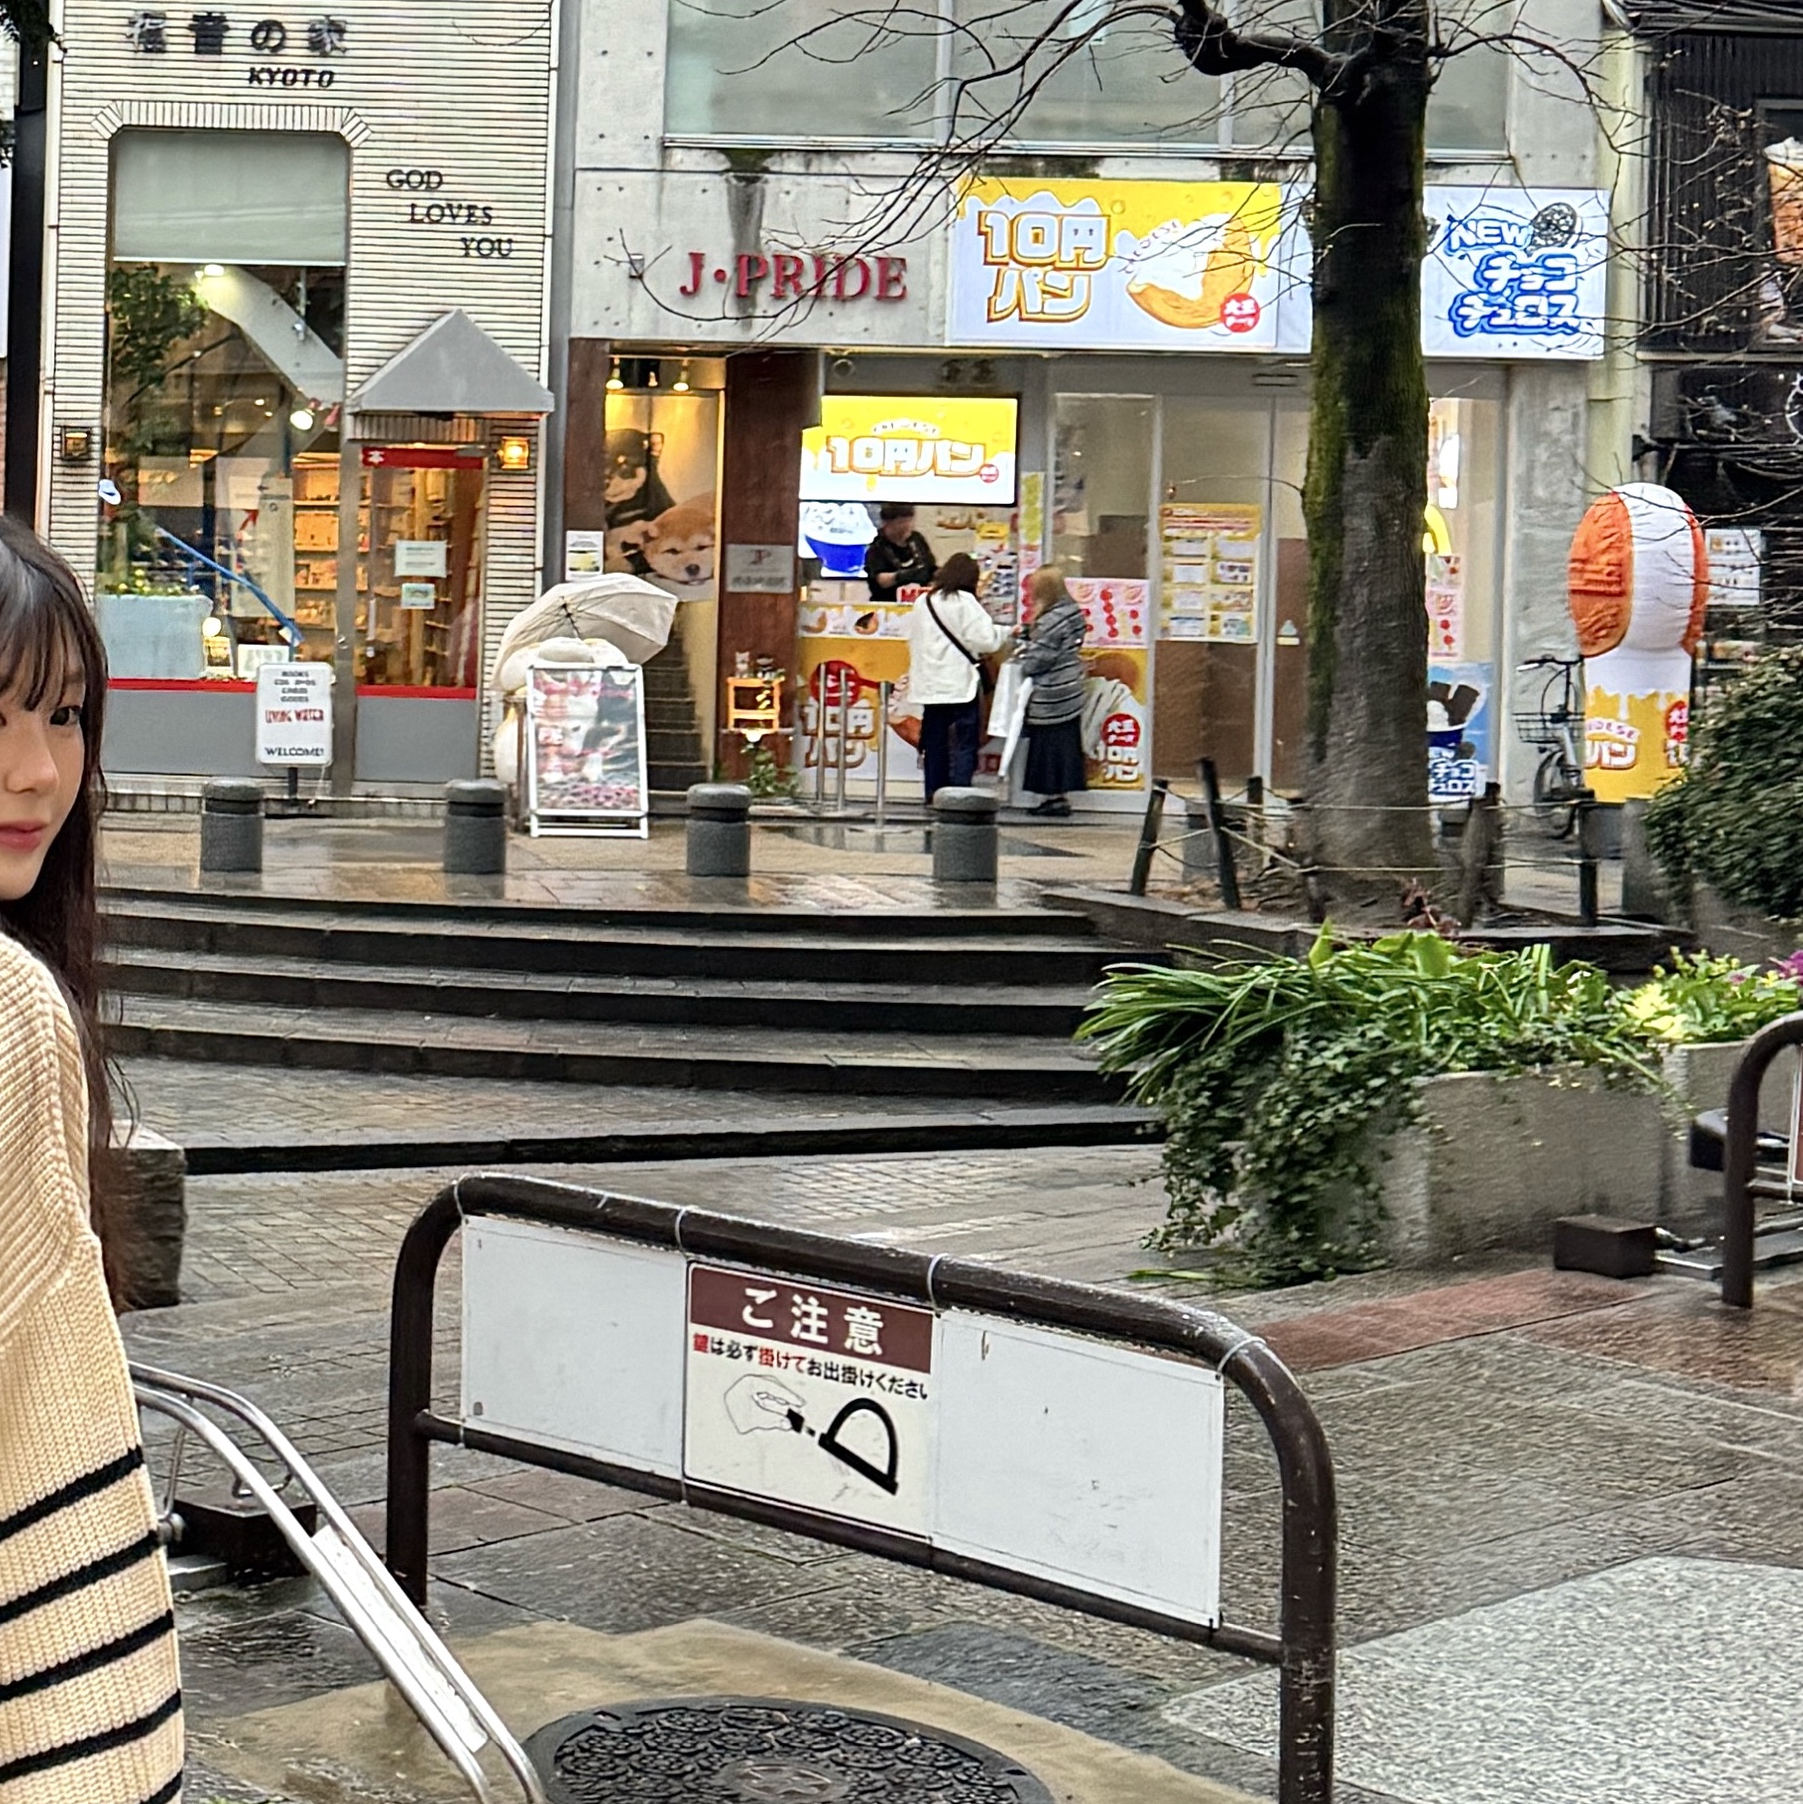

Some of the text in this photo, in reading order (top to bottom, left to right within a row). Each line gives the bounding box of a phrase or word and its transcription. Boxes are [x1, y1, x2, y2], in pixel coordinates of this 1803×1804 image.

[249, 67, 335, 88] KYOTO
[387, 169, 443, 191] GOD
[410, 203, 494, 225] LOVES
[461, 237, 513, 257] YOU
[977, 210, 1111, 271] 10円
[1447, 218, 1532, 256] NEW
[986, 267, 1092, 323] パン
[1476, 252, 1578, 296] チョコ
[1451, 292, 1581, 337] チュロス
[826, 434, 986, 478] 10円パン
[742, 1287, 885, 1357] ご注意
